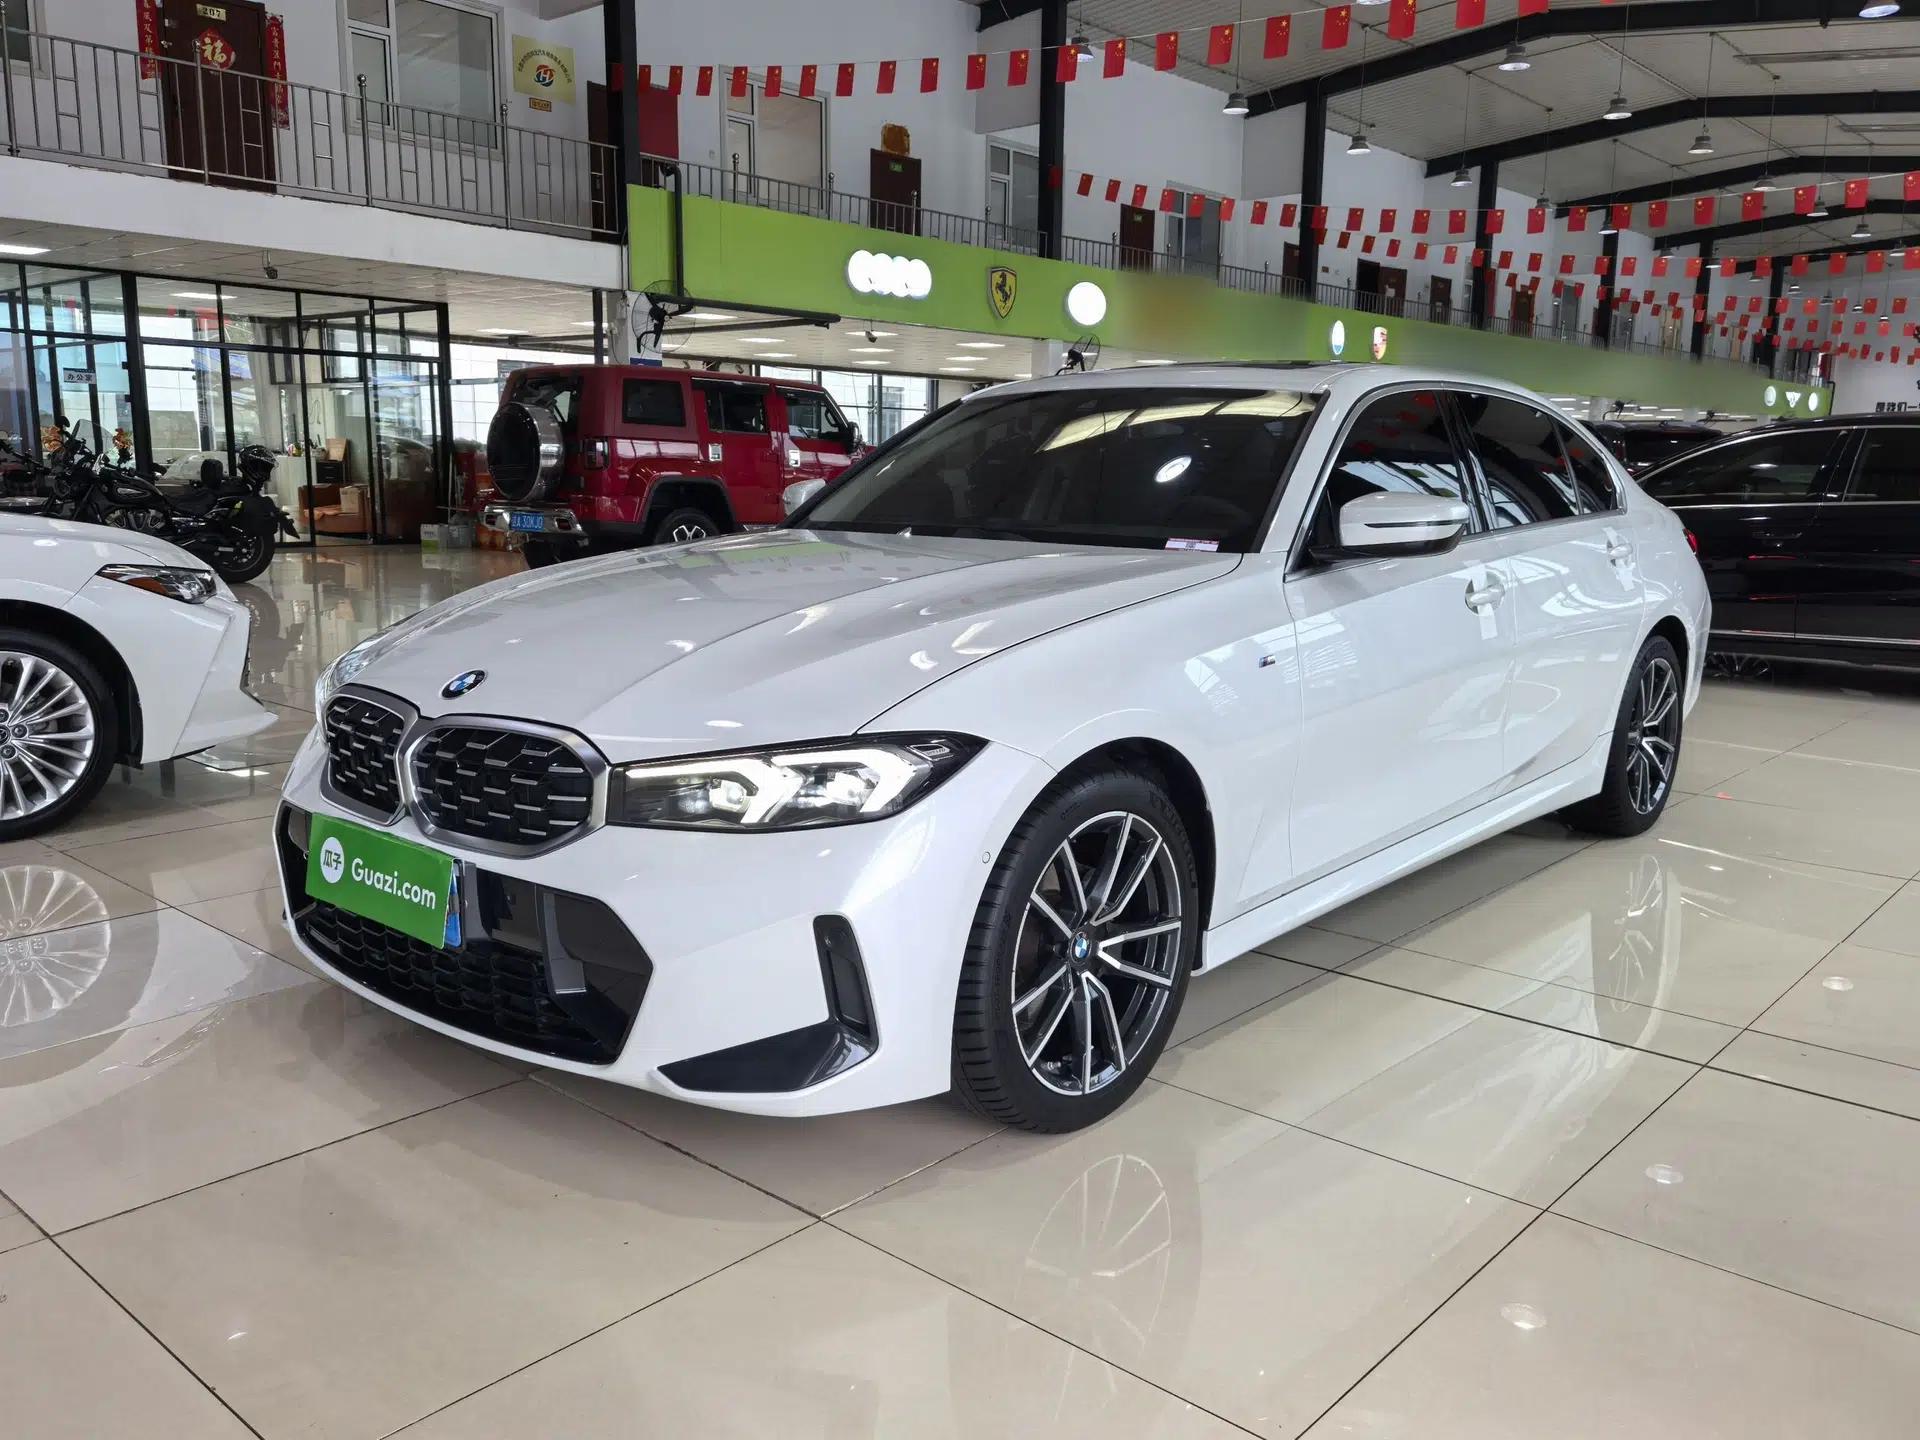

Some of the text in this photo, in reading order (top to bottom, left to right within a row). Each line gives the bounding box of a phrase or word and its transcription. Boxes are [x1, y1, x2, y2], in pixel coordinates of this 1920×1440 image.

[202, 7, 220, 17] 207
[201, 37, 227, 63] 福
[67, 373, 92, 381] 办公室
[323, 848, 342, 870] 瓜子
[351, 858, 436, 910] Guazi.com
